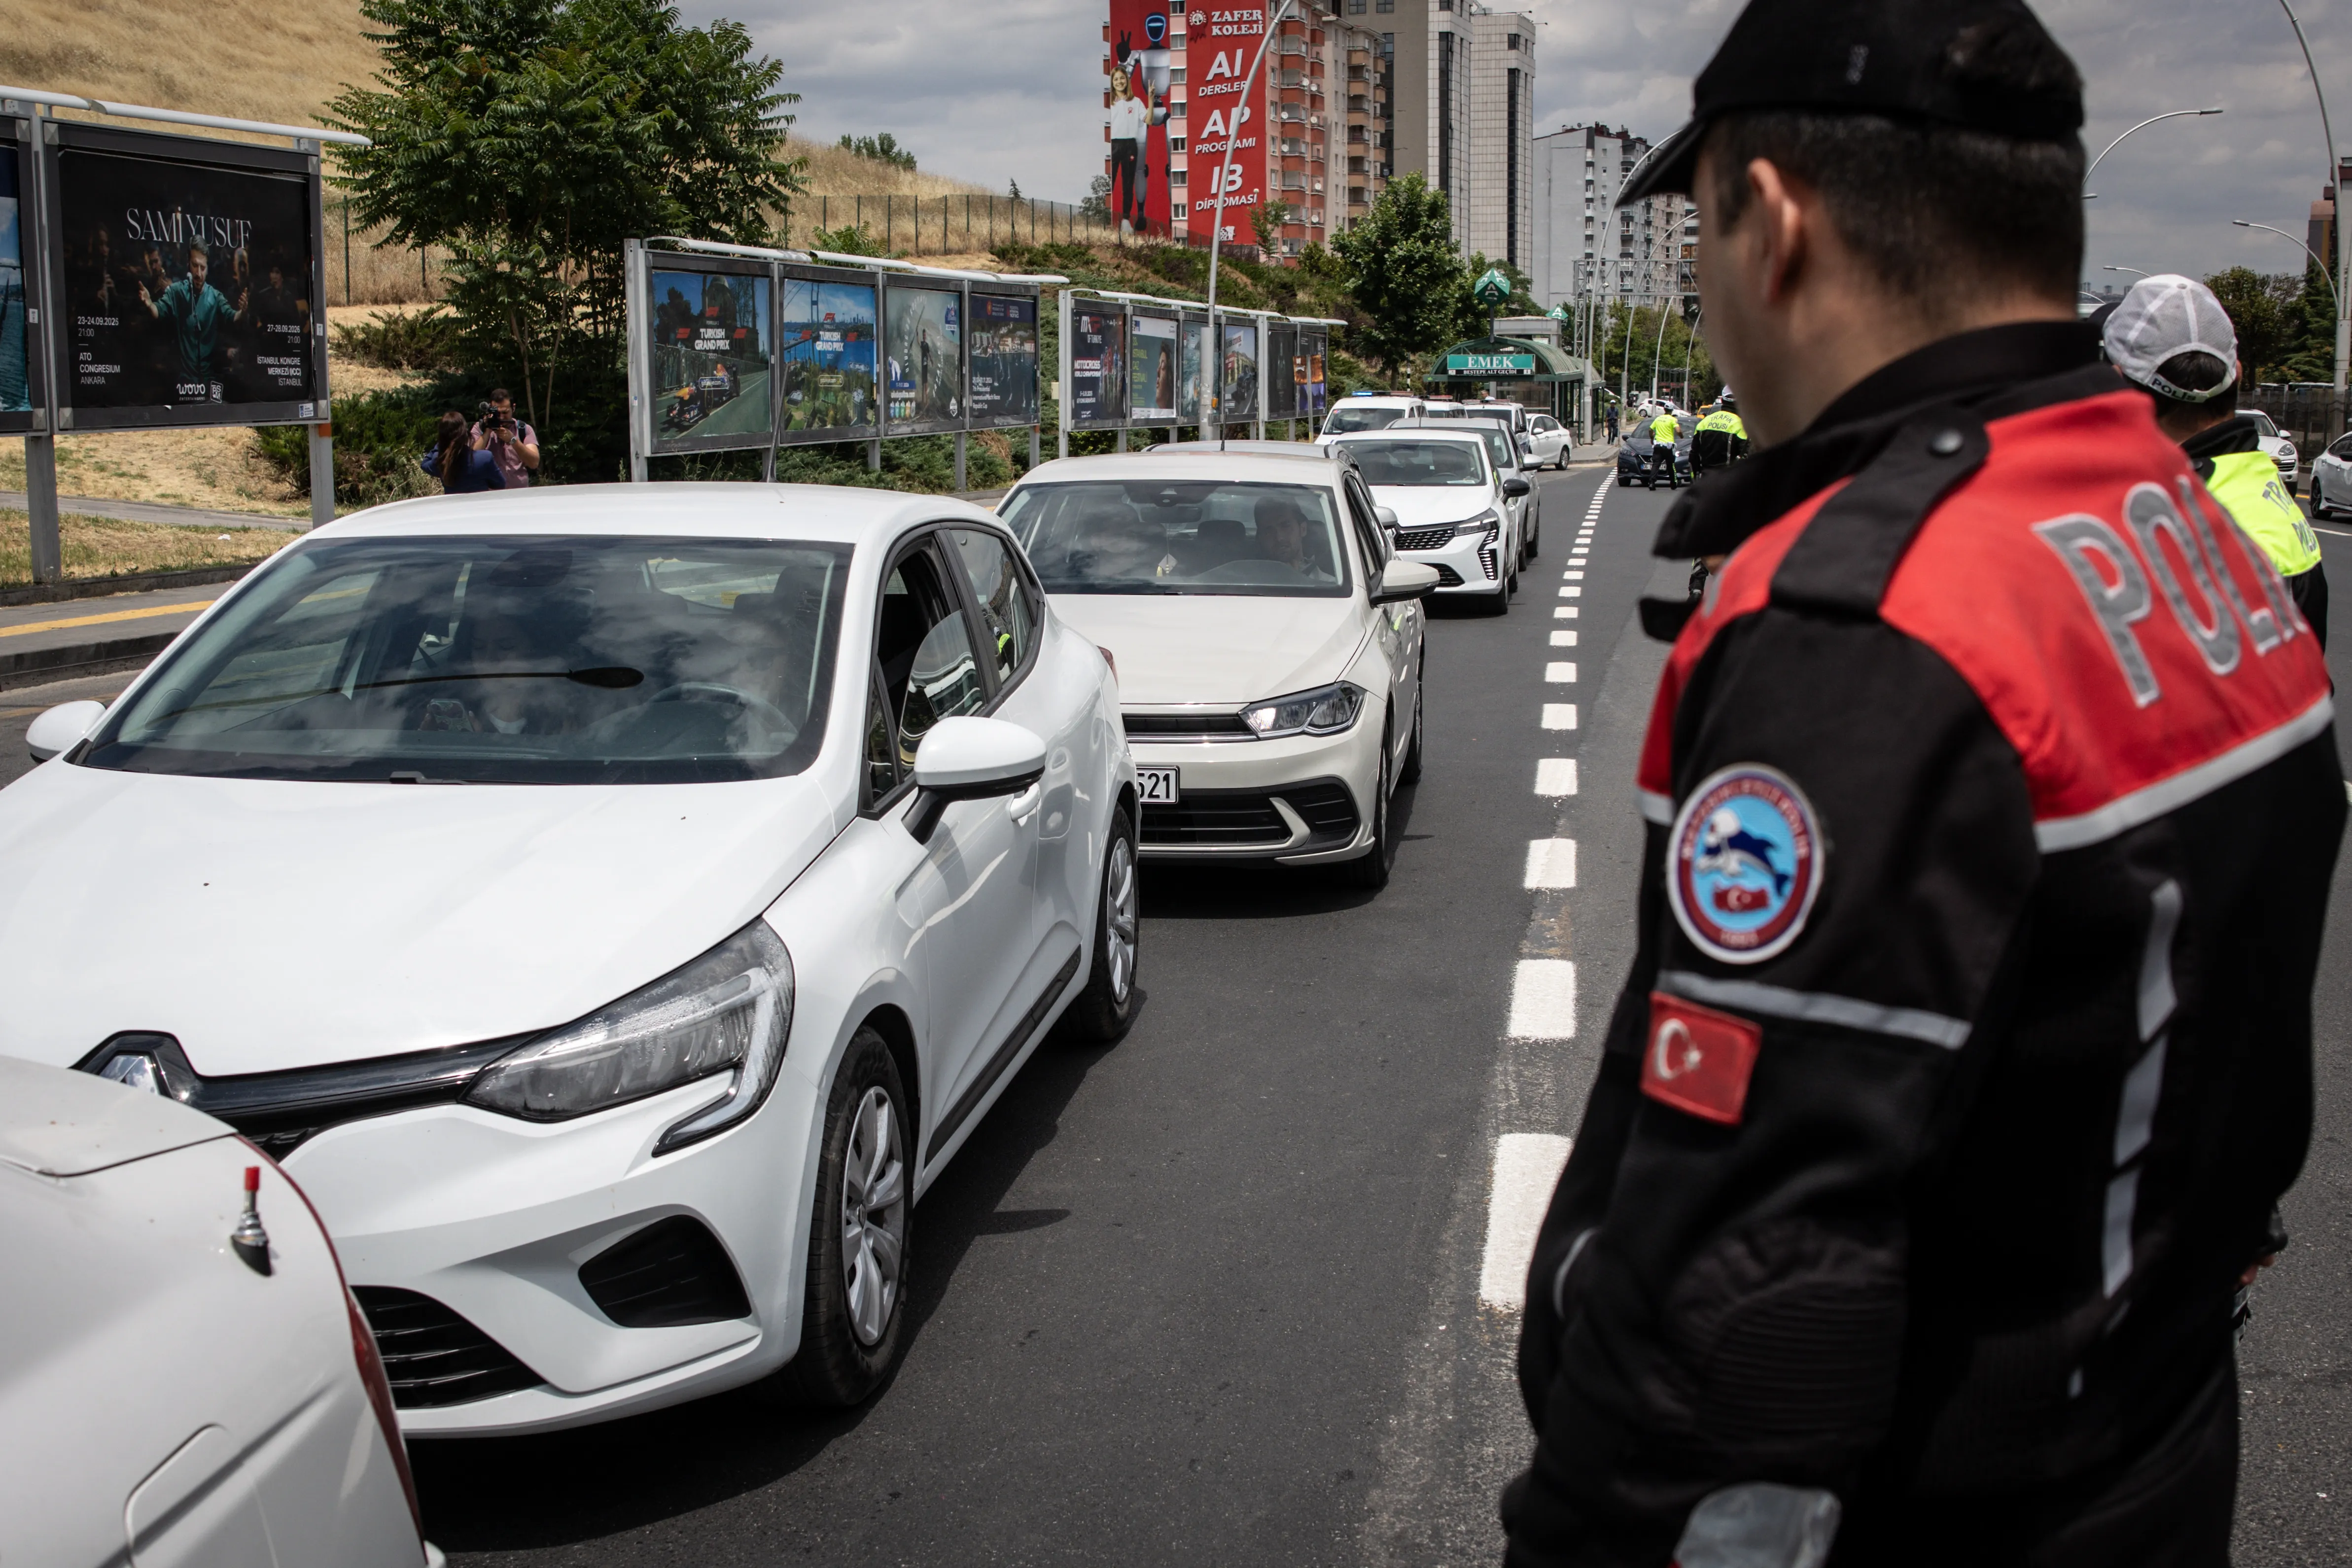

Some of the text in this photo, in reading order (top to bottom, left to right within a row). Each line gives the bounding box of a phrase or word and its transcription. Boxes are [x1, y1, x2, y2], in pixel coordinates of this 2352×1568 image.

[1212, 10, 1264, 22] ZAFER
[1212, 21, 1264, 35] KOLEJİ
[1205, 48, 1243, 81] AI
[1198, 81, 1247, 97] DERSLER
[1200, 106, 1251, 139] AP
[1211, 164, 1243, 194] IB
[185, 214, 252, 248] YUSUF
[77, 316, 119, 325] 23-24.09.2026
[78, 328, 95, 337] 21:00
[267, 324, 300, 333] 27-28.09.2026
[700, 328, 725, 339] TURKISH
[819, 331, 841, 341] TURKISH
[695, 340, 730, 350] GRAND PRIX
[816, 341, 844, 351] GRAND PRIX
[79, 352, 92, 361] ATO
[257, 355, 280, 364] İSTANBUL
[1075, 360, 1100, 369] MOTOCROSS
[1467, 356, 1514, 368] EMEK
[79, 364, 120, 373] CONGRESIUM
[268, 366, 289, 375] MERKEZİ
[279, 377, 302, 386] İSTANBUL
[1137, 772, 1170, 799] 521
